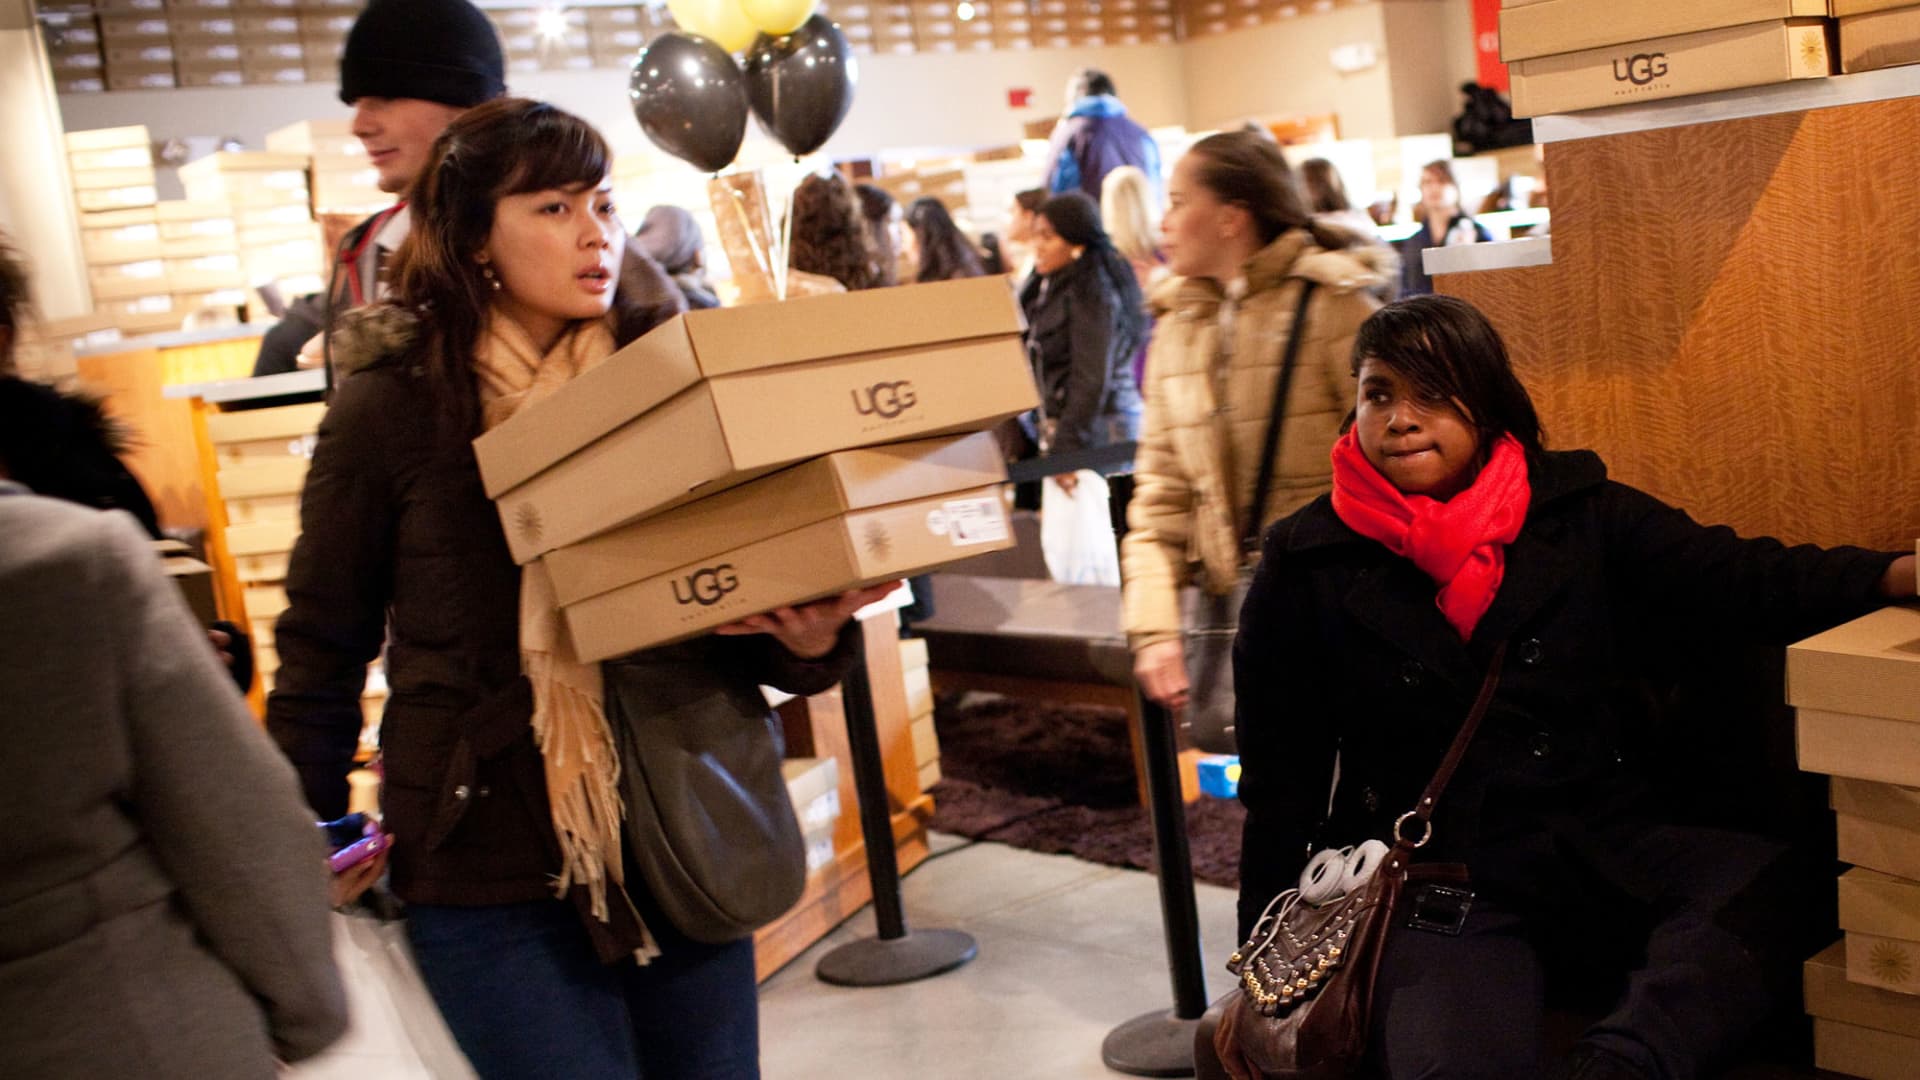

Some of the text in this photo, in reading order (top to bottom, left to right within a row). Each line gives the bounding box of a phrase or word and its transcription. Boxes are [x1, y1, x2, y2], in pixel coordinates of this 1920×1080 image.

[1613, 53, 1668, 85] UGG
[851, 380, 917, 418] UGG
[671, 564, 738, 605] UGG
